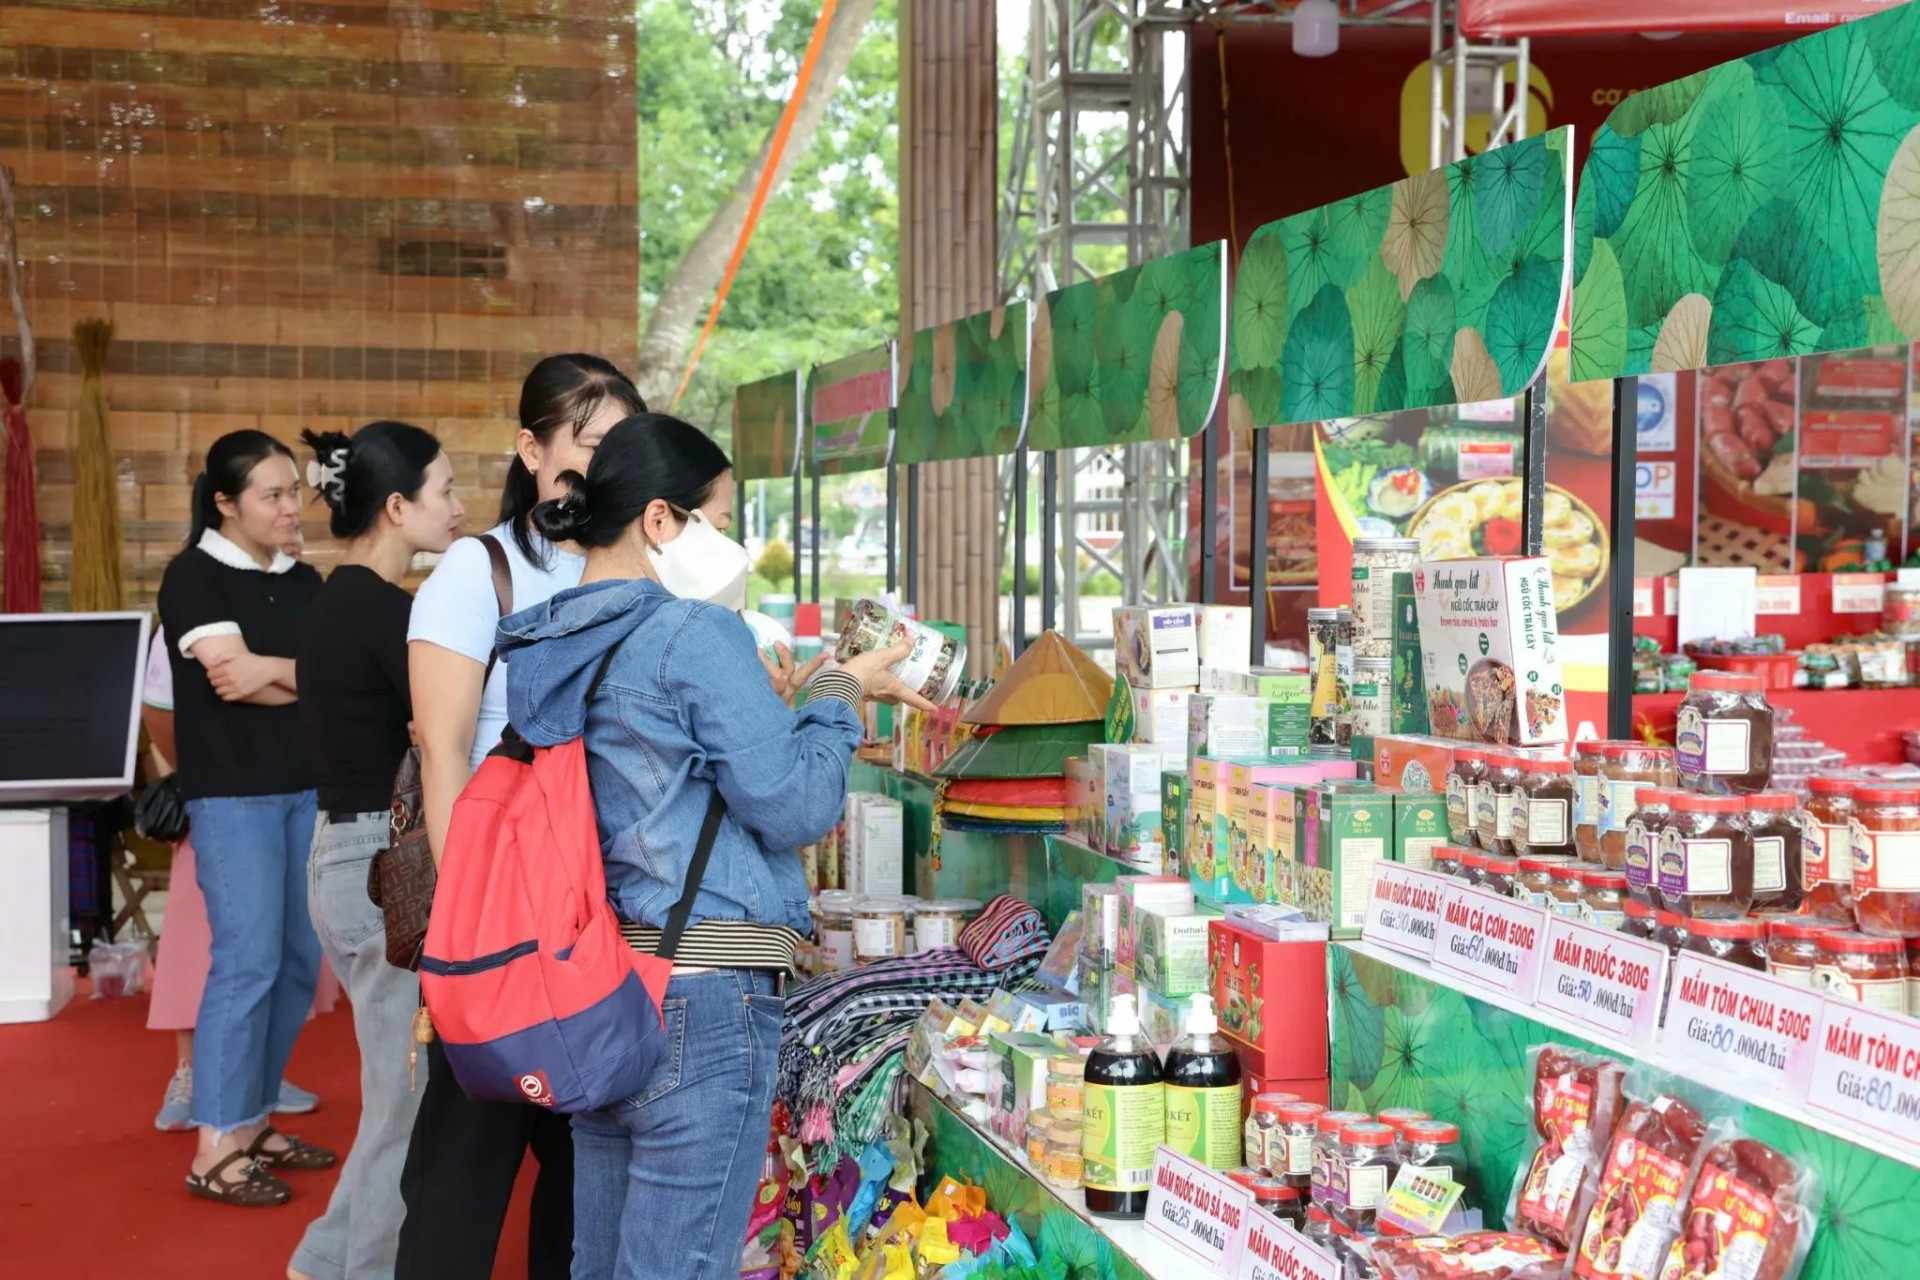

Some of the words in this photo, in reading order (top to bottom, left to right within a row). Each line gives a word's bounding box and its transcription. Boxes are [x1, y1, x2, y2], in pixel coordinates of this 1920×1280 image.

[1391, 877, 1412, 907] RUỐC
[1411, 883, 1427, 912] XÀO
[1445, 895, 1470, 929] MẮM
[1470, 905, 1484, 934] CÁ
[1508, 923, 1535, 951] 500G
[1553, 932, 1583, 969] MẮM
[1582, 943, 1616, 981] RUỐC
[1618, 959, 1650, 992] 380G
[1679, 969, 1710, 1004] MẮM
[1710, 982, 1740, 1021] TÔM
[1739, 995, 1774, 1031] CHUA
[1776, 1008, 1812, 1043] 500G
[1825, 1016, 1863, 1062] MẮM
[1867, 1033, 1901, 1075] TÔM
[1156, 1160, 1175, 1192] MẮM
[1174, 1172, 1194, 1203] RUỐC
[1193, 1182, 1211, 1214] XÀO
[1210, 1190, 1222, 1219] SẢ
[1221, 1203, 1241, 1231] 200G
[1248, 1225, 1271, 1263] MẮM
[1271, 1246, 1299, 1280] RUỐC
